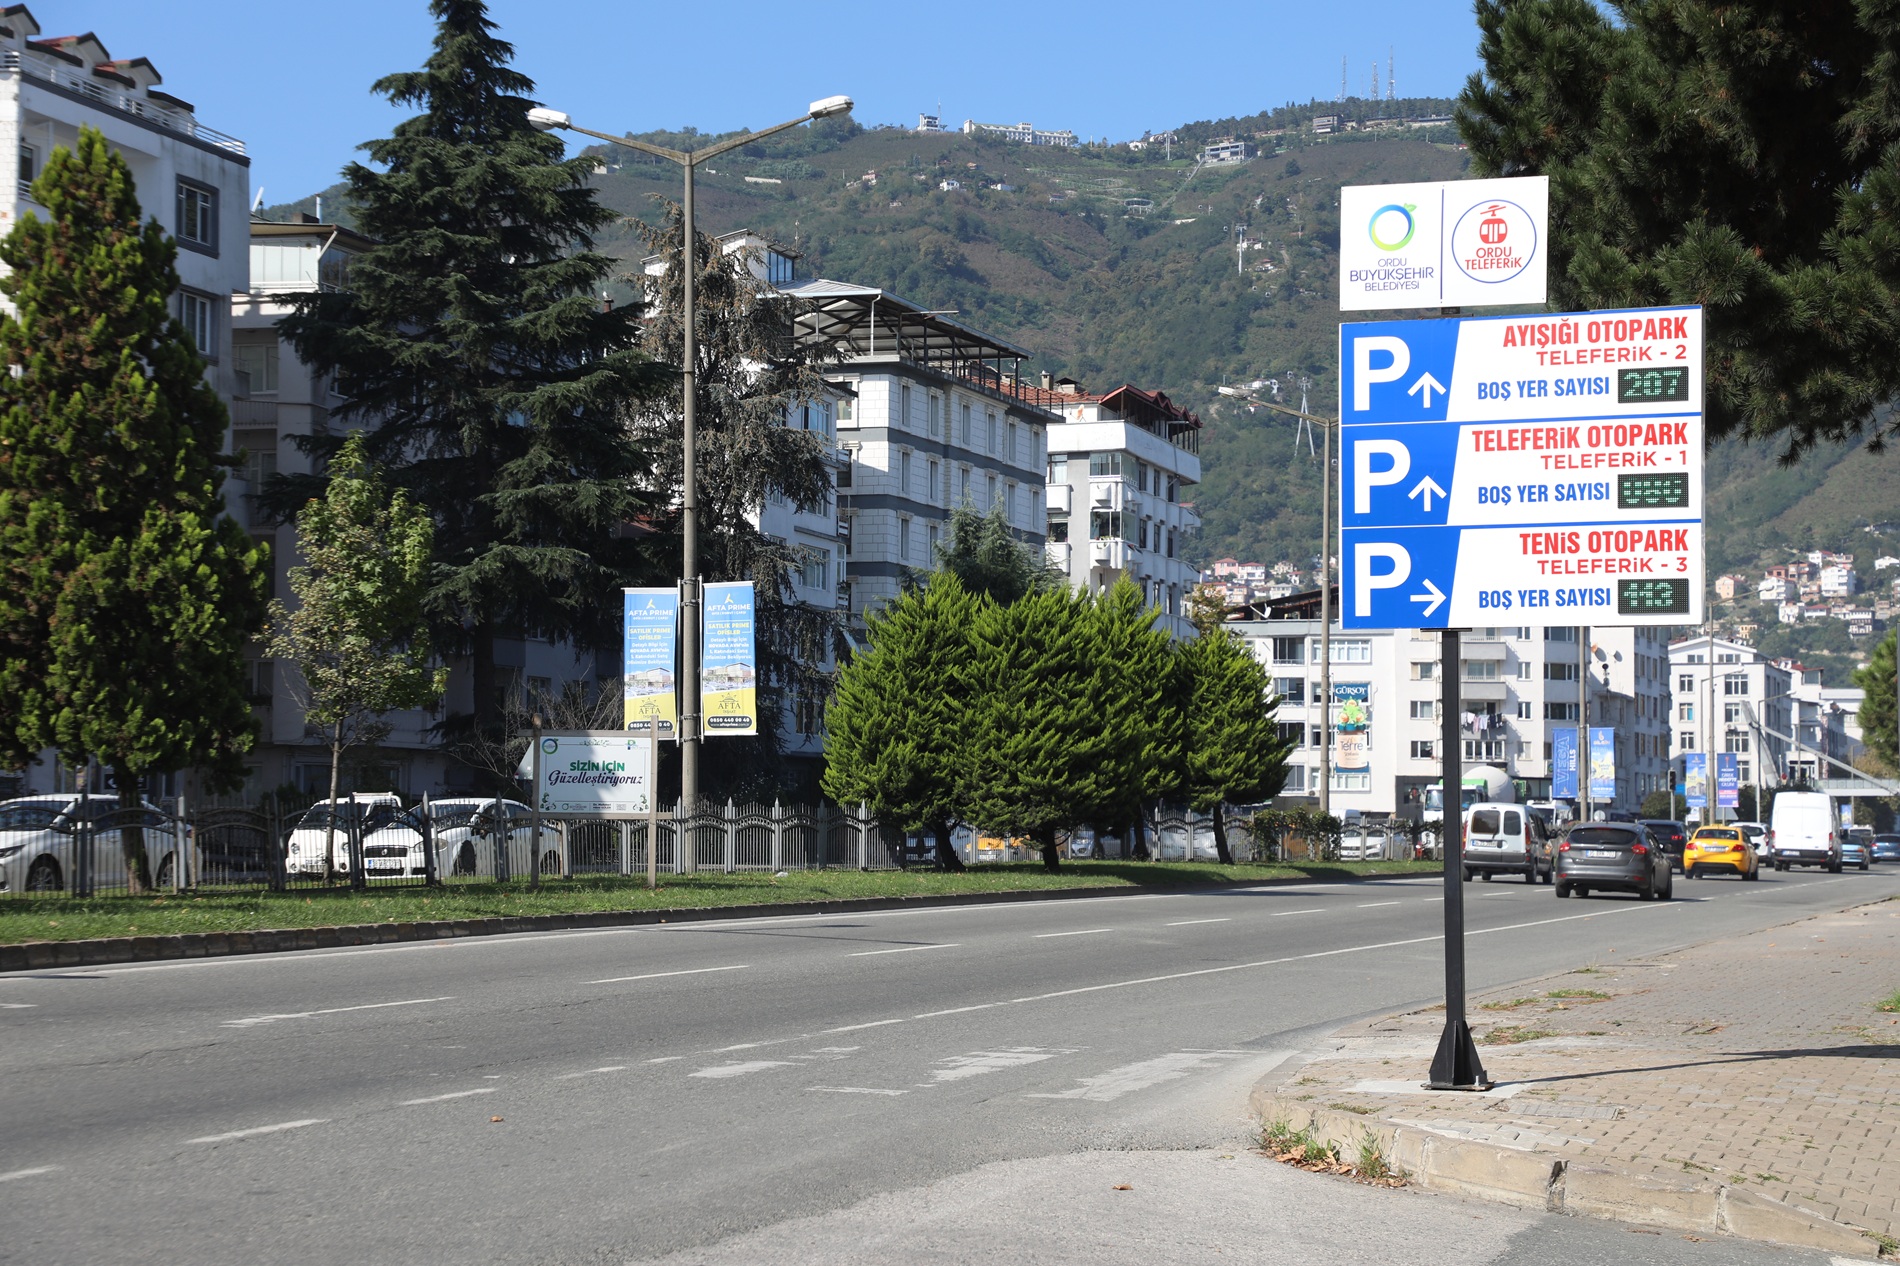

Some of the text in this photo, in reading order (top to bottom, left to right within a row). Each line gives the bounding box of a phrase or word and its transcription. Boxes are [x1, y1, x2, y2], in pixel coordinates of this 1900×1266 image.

[1378, 258, 1407, 268] ORDU
[1476, 246, 1512, 258] ORDU
[1503, 316, 1688, 348] AYIŞIĞI OTOPARK
[1675, 344, 1687, 360] 2
[1353, 335, 1411, 411] P
[1624, 370, 1681, 397] 207
[1477, 377, 1610, 400] BOŞ YER SAYISI
[1587, 422, 1688, 448] OTOPARK
[1679, 450, 1687, 465] 1
[1354, 438, 1411, 514] P
[1478, 482, 1610, 506] BOŞ YER SAYISI
[1588, 529, 1689, 553] OTOPARK
[1676, 557, 1688, 572] 3
[1354, 542, 1412, 617] P
[728, 603, 751, 611] PRIME
[1479, 588, 1611, 611] BOŞ YER SAYISI
[1335, 685, 1367, 695] GÜRSOY
[570, 760, 625, 773] SİZİN İÇİN
[1556, 736, 1570, 784] VEGA
[1569, 748, 1577, 772] HILLS
[548, 769, 643, 787] Güzelleştiriyoruz
